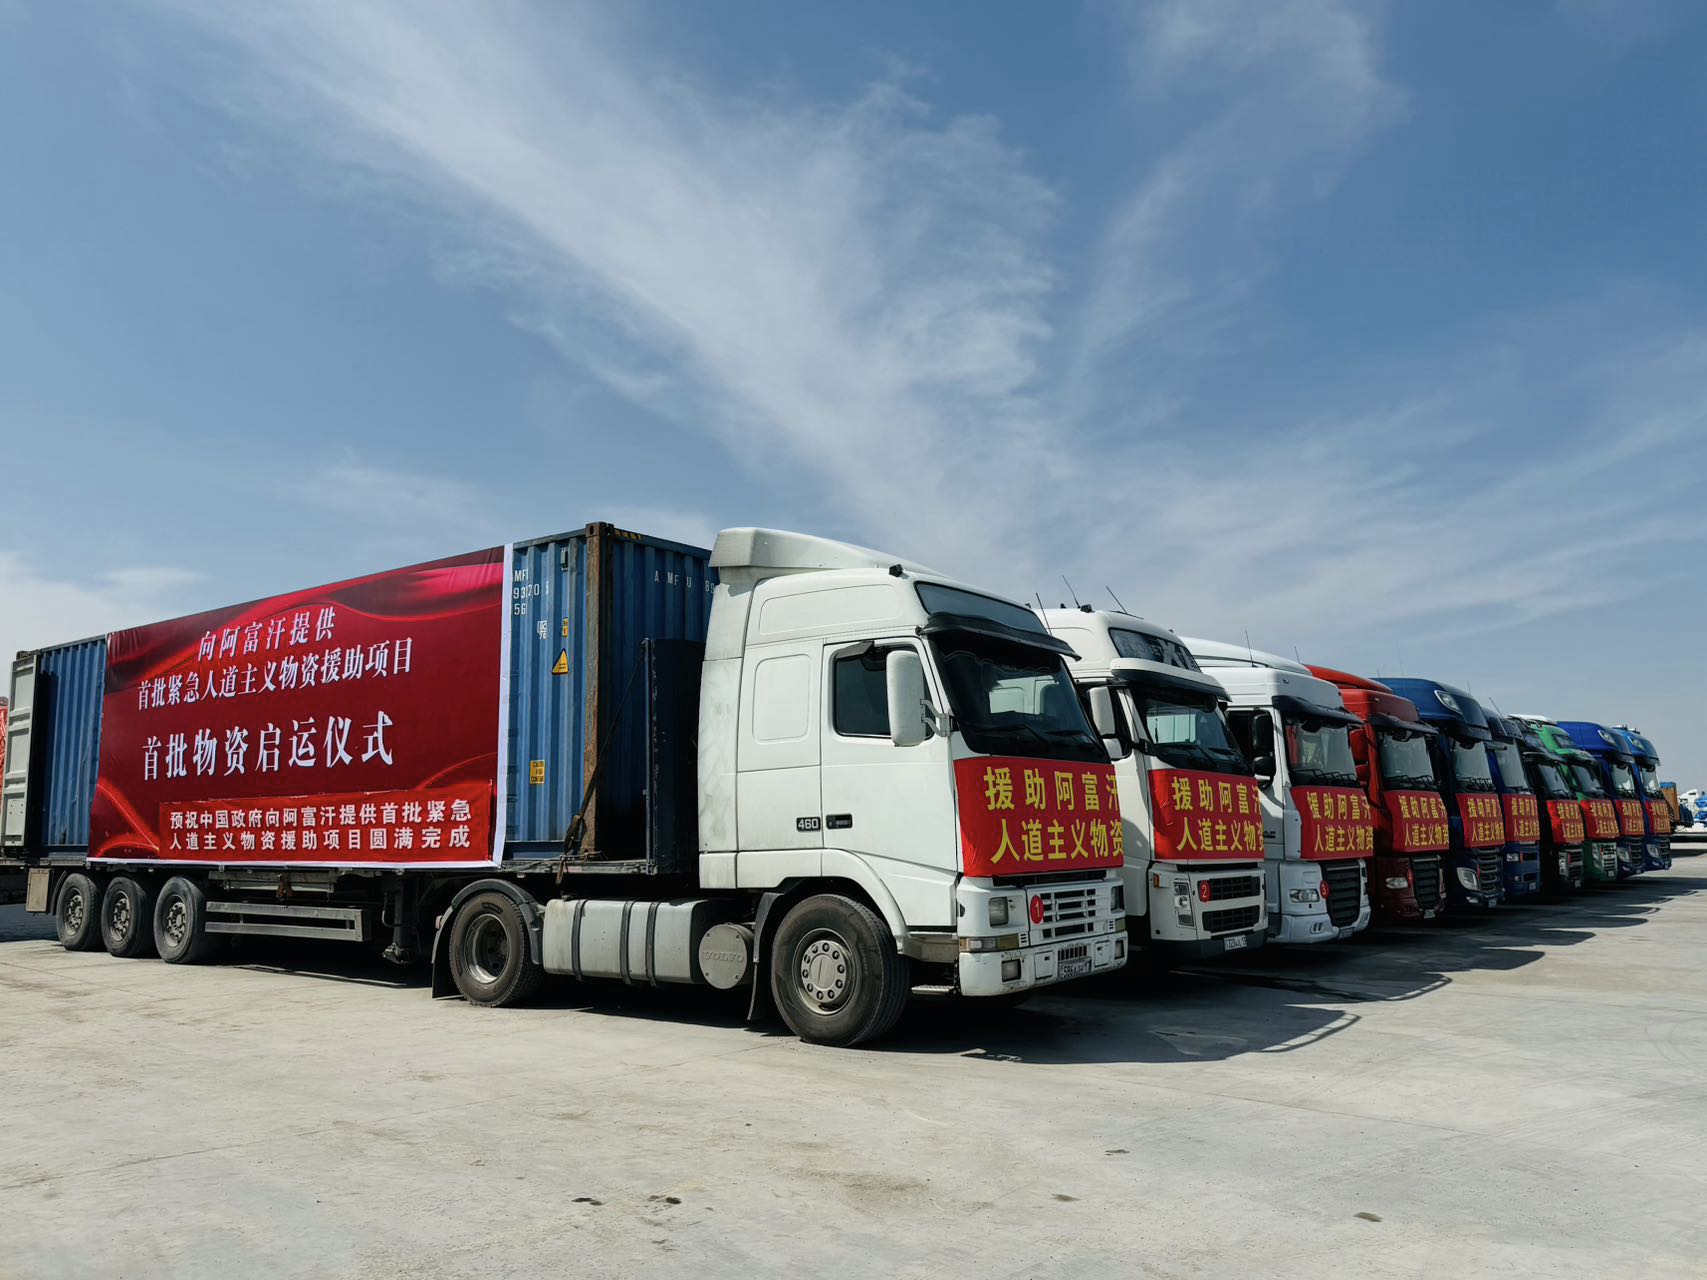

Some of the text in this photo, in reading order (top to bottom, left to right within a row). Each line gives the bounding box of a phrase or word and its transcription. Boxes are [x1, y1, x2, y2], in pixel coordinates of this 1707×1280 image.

[198, 606, 335, 661] 向阿富汗提供
[138, 637, 413, 711] 首批紧急人道主义物资援助项目
[142, 711, 393, 781] 首批物资启运仪式
[984, 766, 1118, 811] 援助阿富汗
[170, 799, 471, 830] 预祝中国政府向阿富汗提供首批紧急
[798, 818, 819, 830] 460
[170, 825, 471, 851] 人道主义物资援助项目圆满完成
[990, 818, 1123, 864] 人道主义物资
[1202, 884, 1207, 898] 2
[1321, 884, 1326, 895] 3
[1035, 900, 1040, 919] 1
[704, 951, 745, 963] VOLVO
